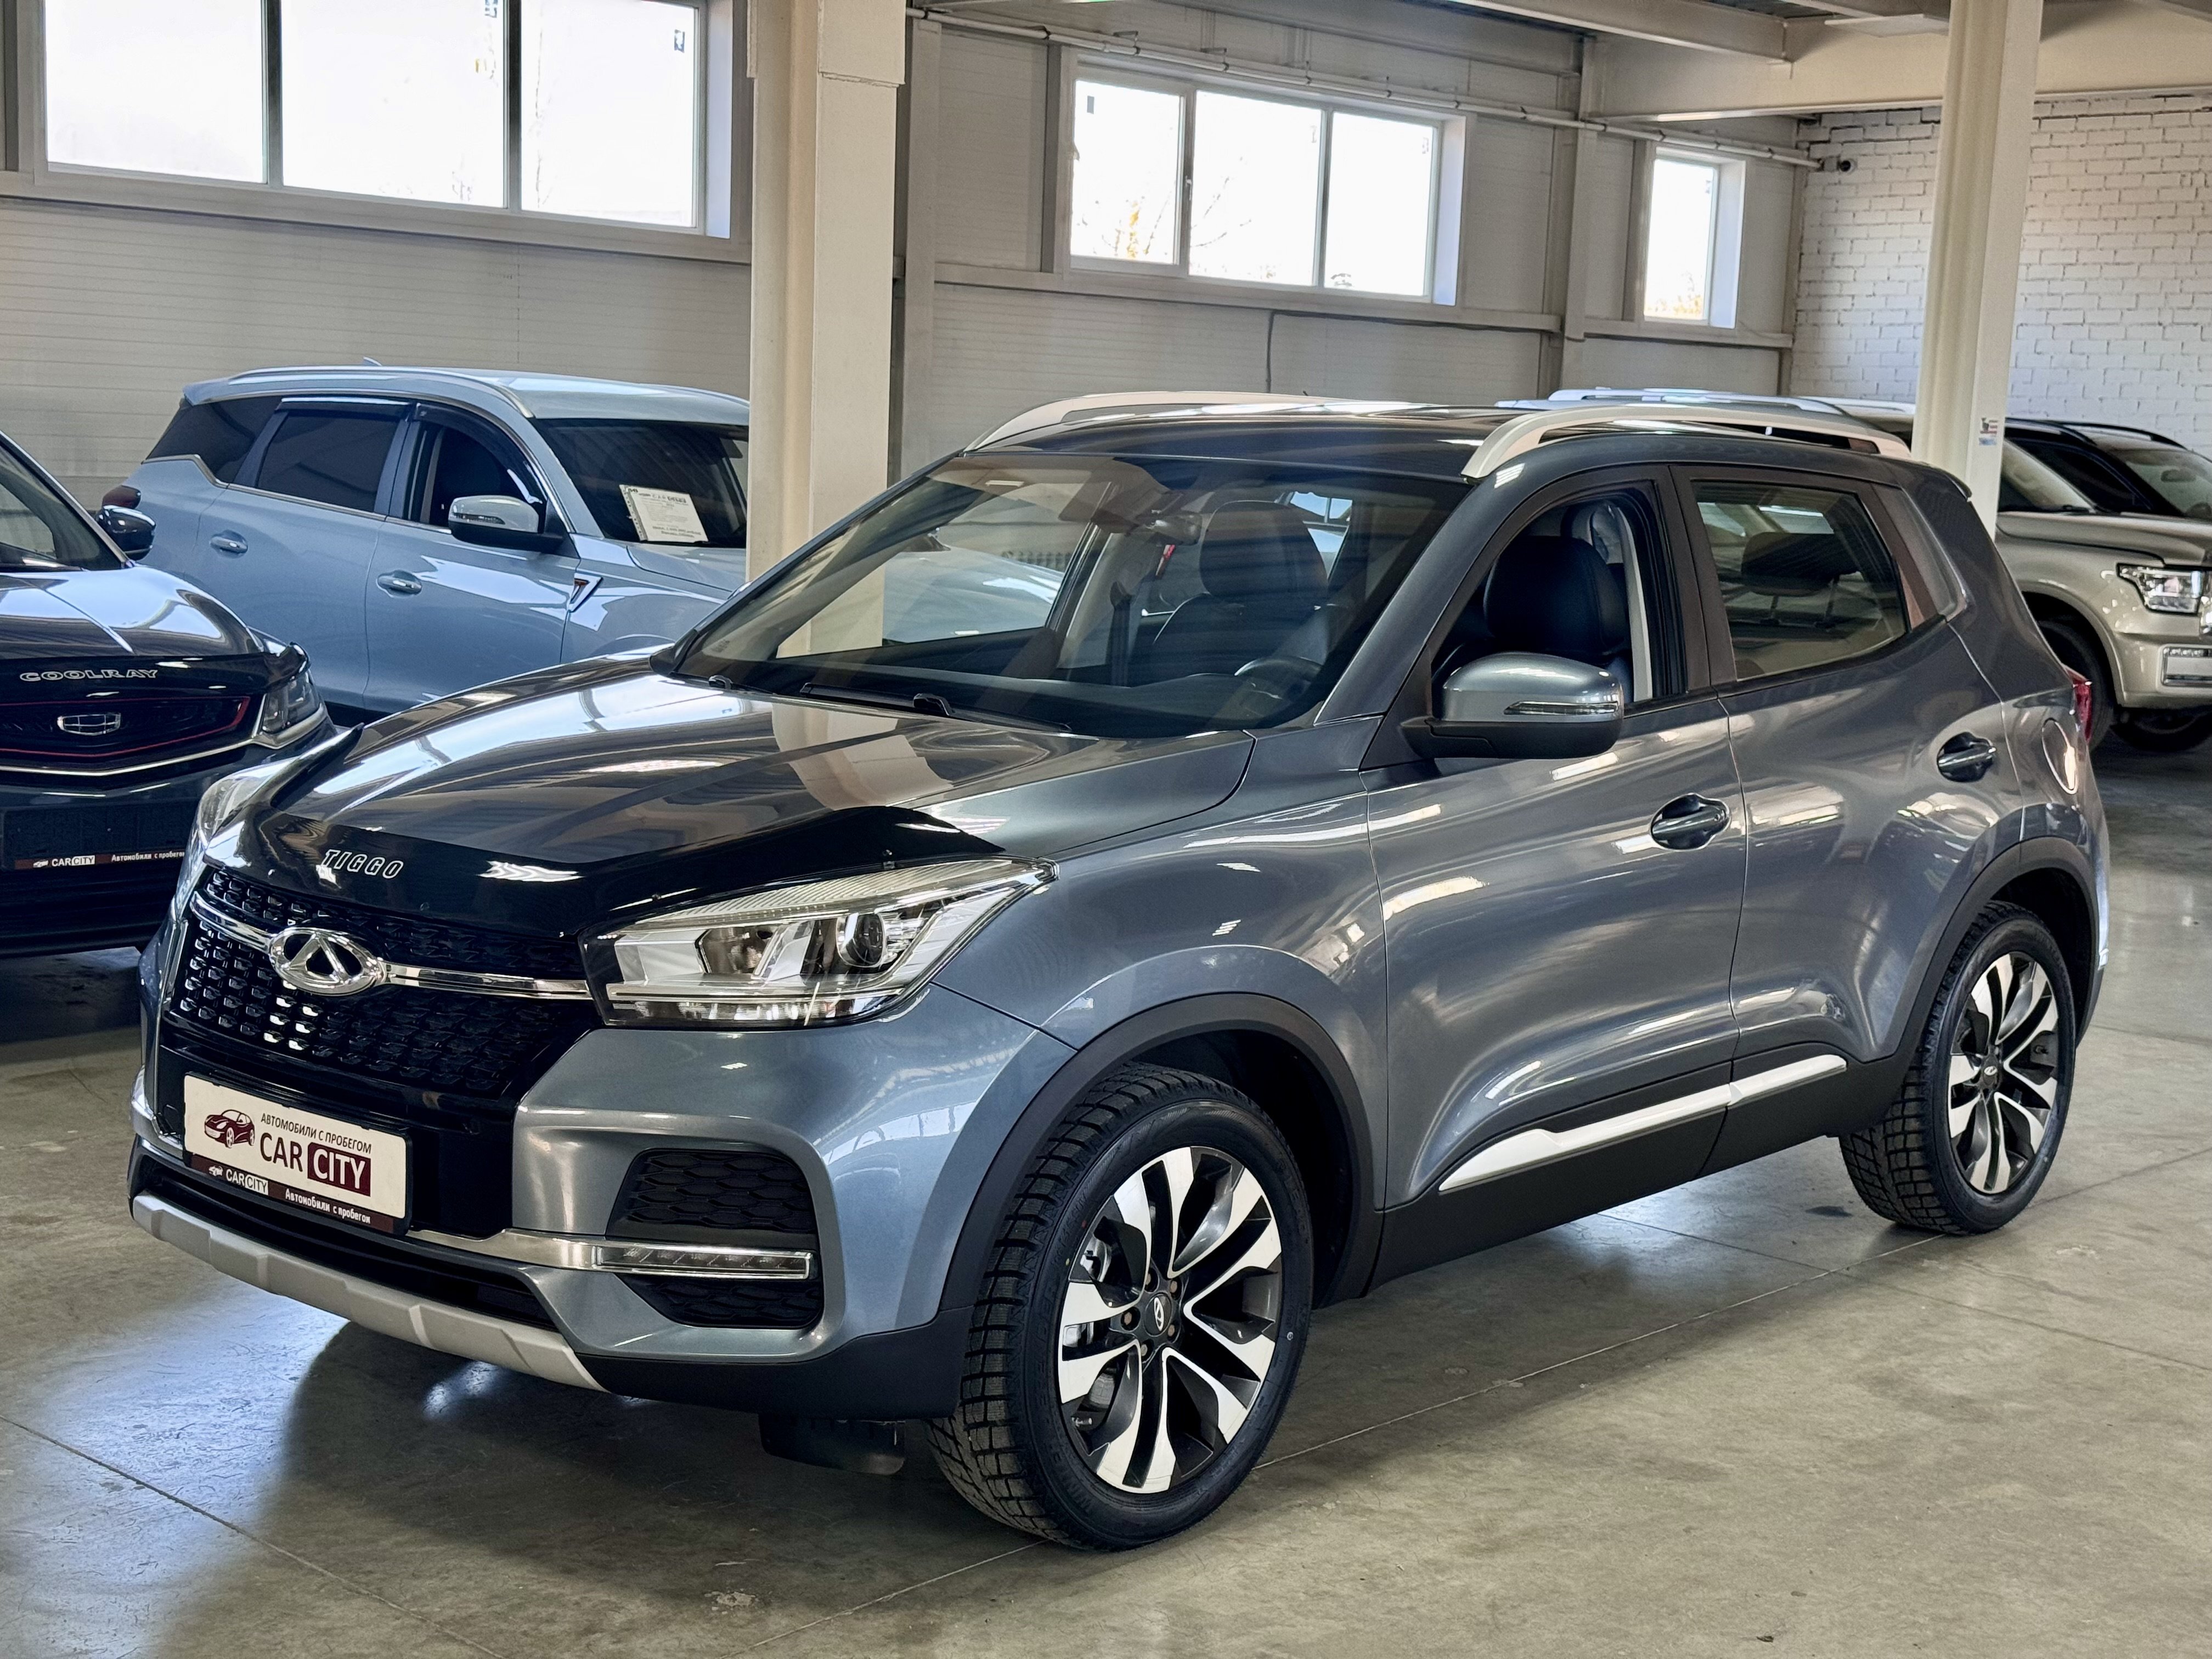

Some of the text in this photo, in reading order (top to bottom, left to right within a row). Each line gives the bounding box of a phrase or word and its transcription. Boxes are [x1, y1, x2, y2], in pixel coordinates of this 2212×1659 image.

[20, 669, 158, 681] COOLRAY
[111, 853, 152, 862] Автомобили
[320, 849, 404, 879] TIGGO
[261, 1113, 372, 1154] АВТОМОБИЛИ С ПРОБЕГОМ
[260, 1132, 366, 1189] CAR CITY
[285, 1188, 330, 1212] Автомобили
[338, 1207, 371, 1224] пробегом
